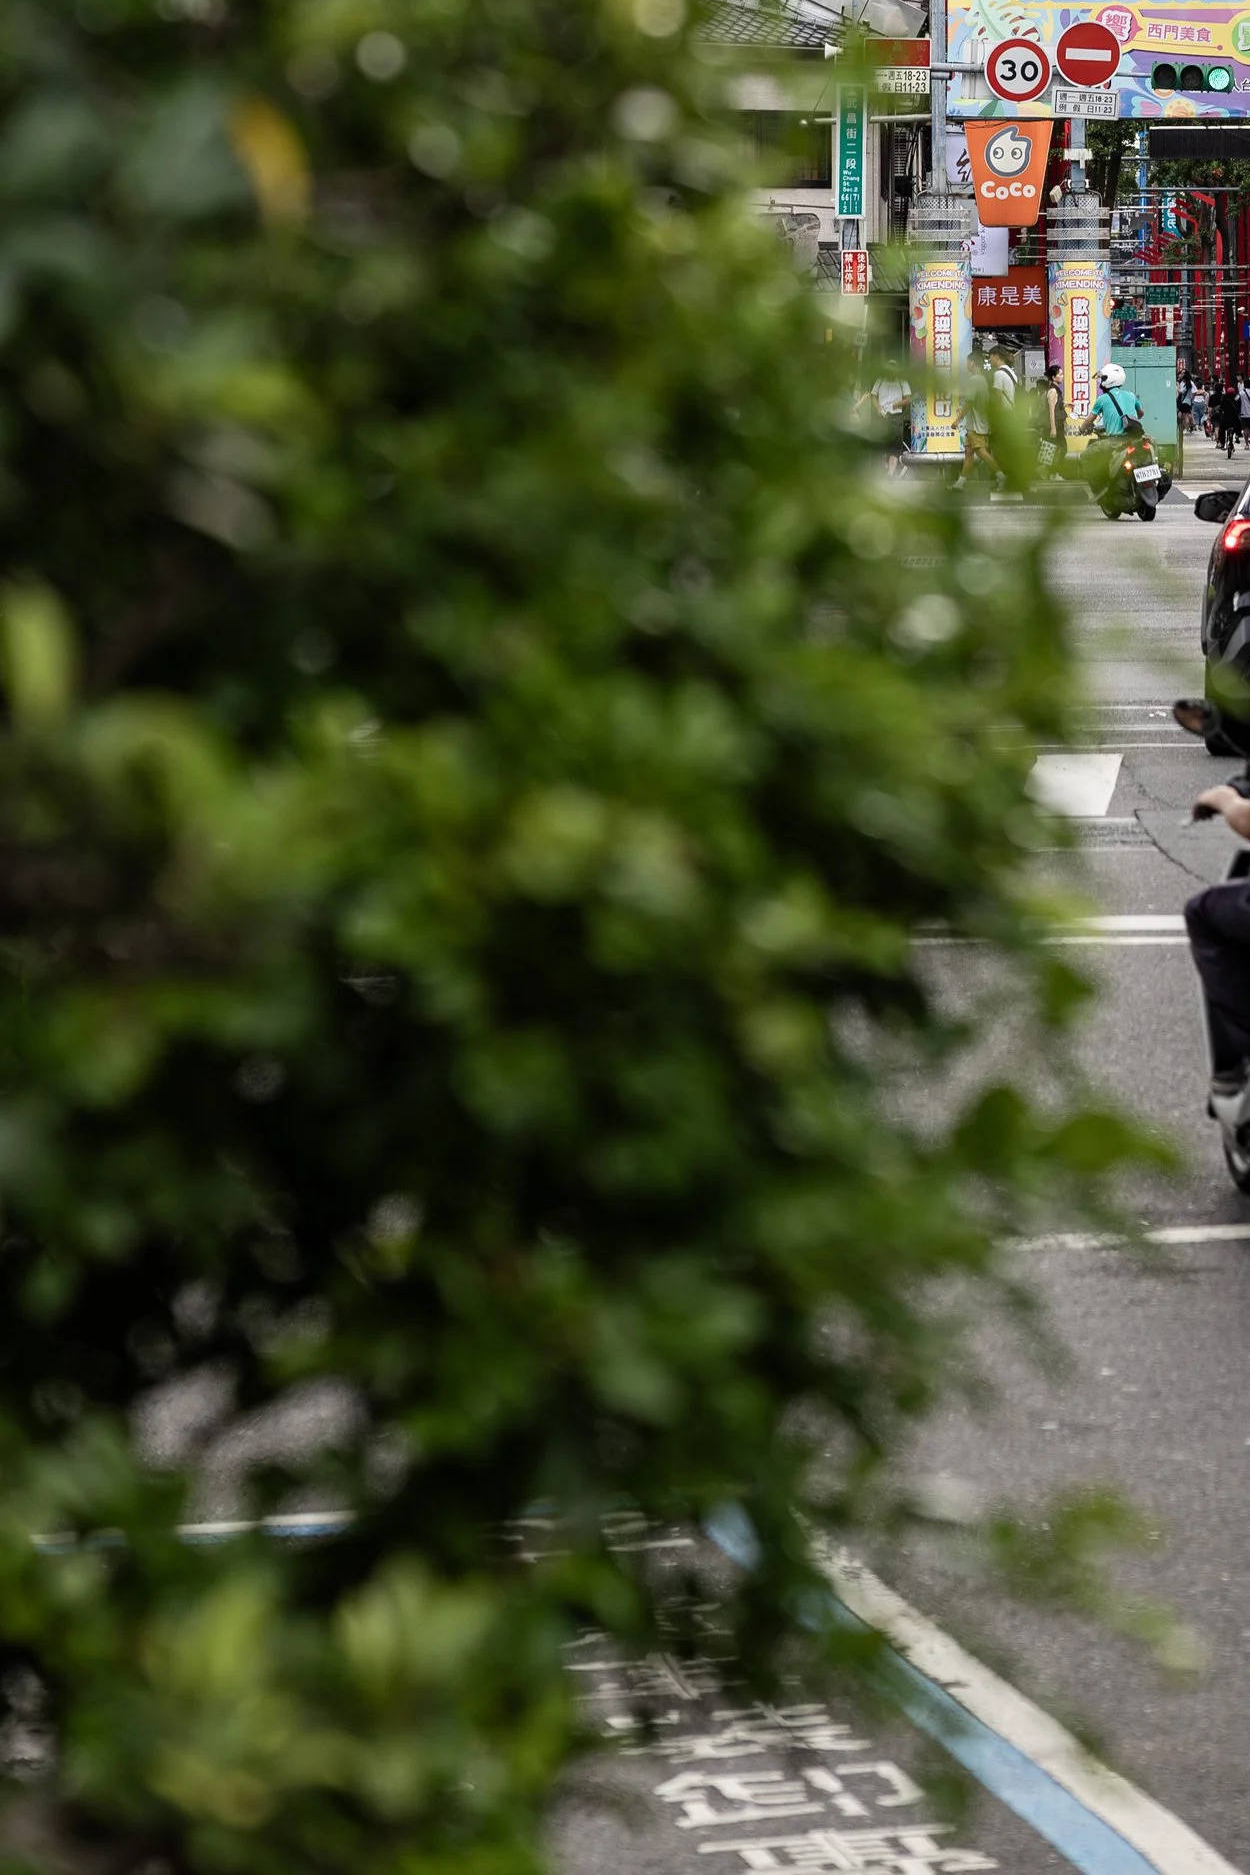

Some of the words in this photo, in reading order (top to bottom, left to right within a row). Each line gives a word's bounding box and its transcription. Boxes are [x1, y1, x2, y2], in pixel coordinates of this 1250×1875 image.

[1146, 22, 1212, 44] 西門美食
[999, 58, 1039, 82] 30
[980, 180, 1036, 200] CoCo
[844, 252, 854, 293] 禁止停車
[916, 269, 956, 278] WELCOME
[956, 269, 968, 278] TO
[1055, 269, 1094, 277] WELCOME
[1094, 269, 1105, 277] TO
[915, 280, 967, 290] XIMENDING
[1054, 279, 1106, 290] XIMENDING
[977, 285, 1043, 306] 康是美
[1071, 296, 1090, 418] 歡迎來到西門町
